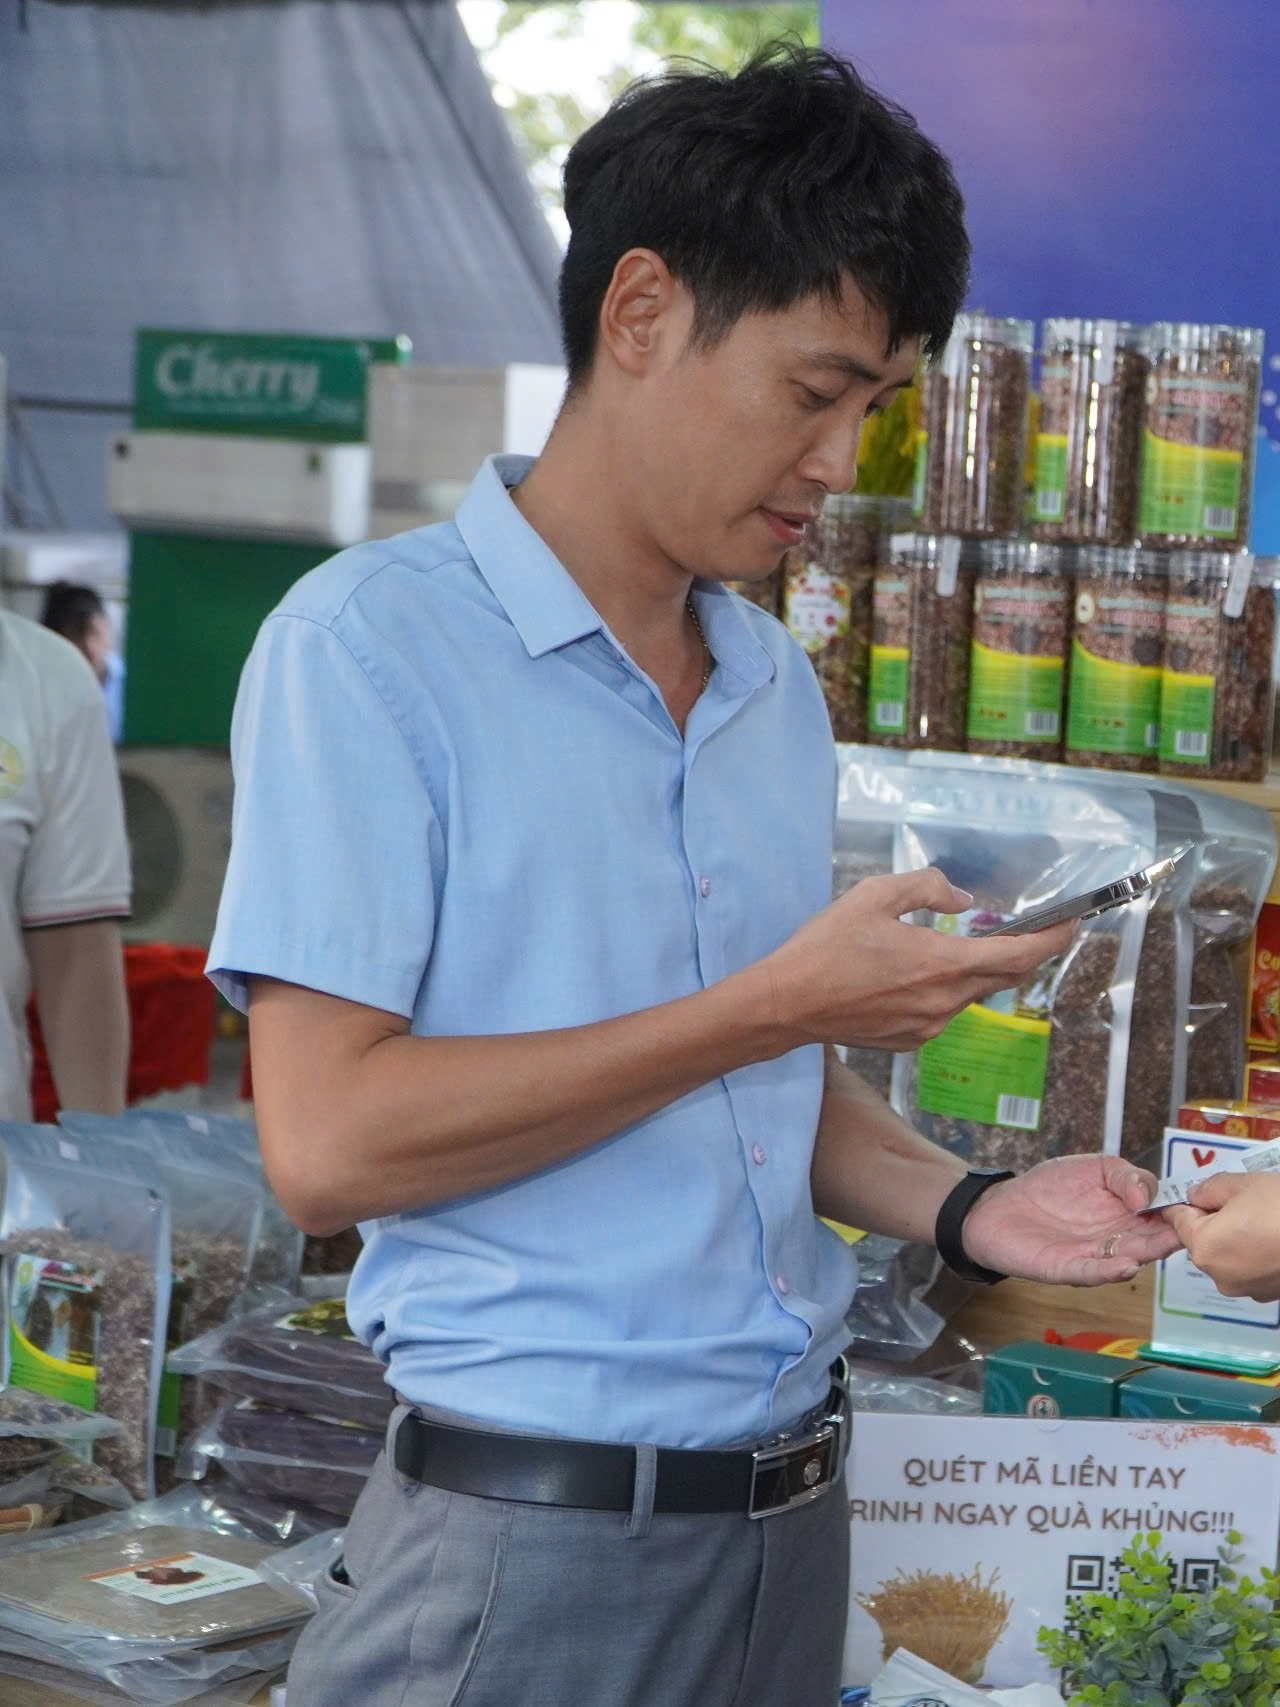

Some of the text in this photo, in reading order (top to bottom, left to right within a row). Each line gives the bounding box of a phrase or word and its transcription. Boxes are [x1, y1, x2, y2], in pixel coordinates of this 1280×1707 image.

[156, 342, 320, 413] Cherry
[903, 1454, 1187, 1490] QUÉT MÃ LIỀN TAY
[850, 1499, 1236, 1535] RINH NGAY QUÀ KHỦNG!!!
